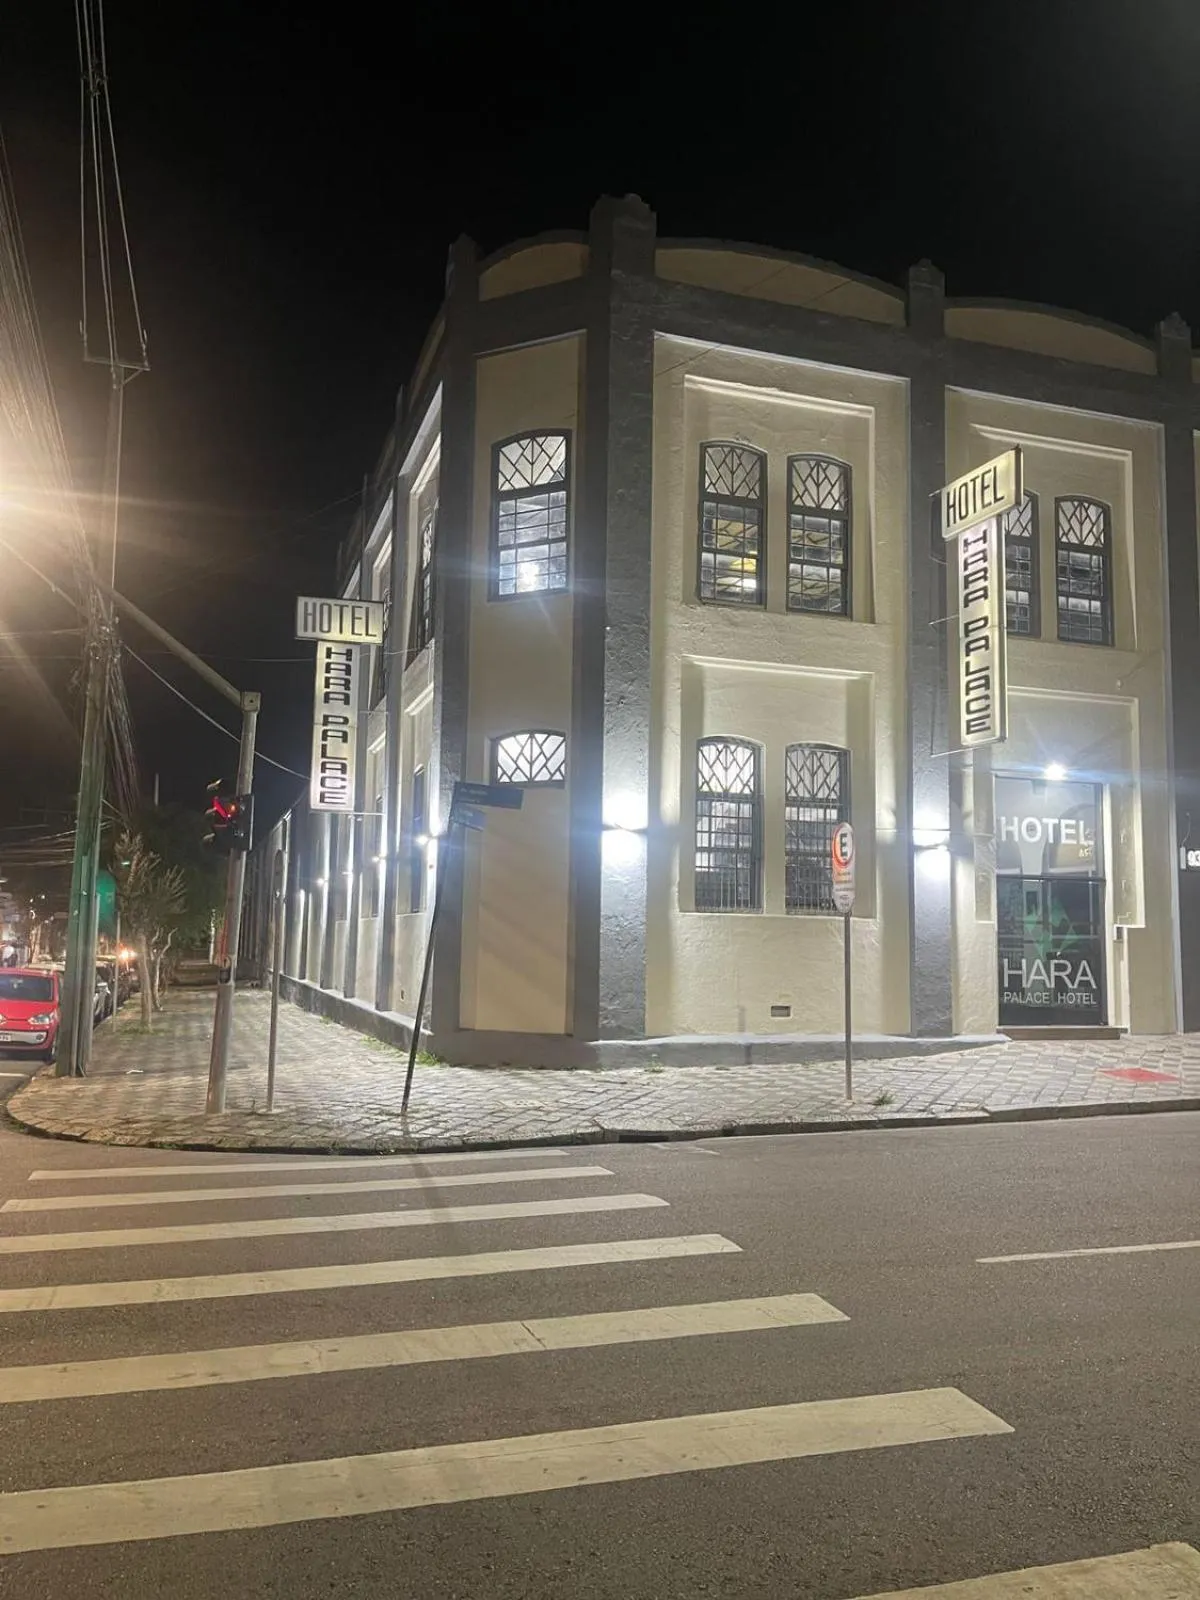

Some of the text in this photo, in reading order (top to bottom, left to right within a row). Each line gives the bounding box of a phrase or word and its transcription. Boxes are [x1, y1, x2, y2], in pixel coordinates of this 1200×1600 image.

[946, 465, 1005, 528] HOTEL
[303, 601, 377, 637] HOTEL
[963, 529, 991, 735] HARA PALACE
[319, 646, 353, 805] HARA PALACE
[839, 832, 848, 857] E
[1000, 815, 1094, 845] HOTEL
[1003, 958, 1097, 989] HARA
[1003, 991, 1097, 1005] PALACE HOTEL
